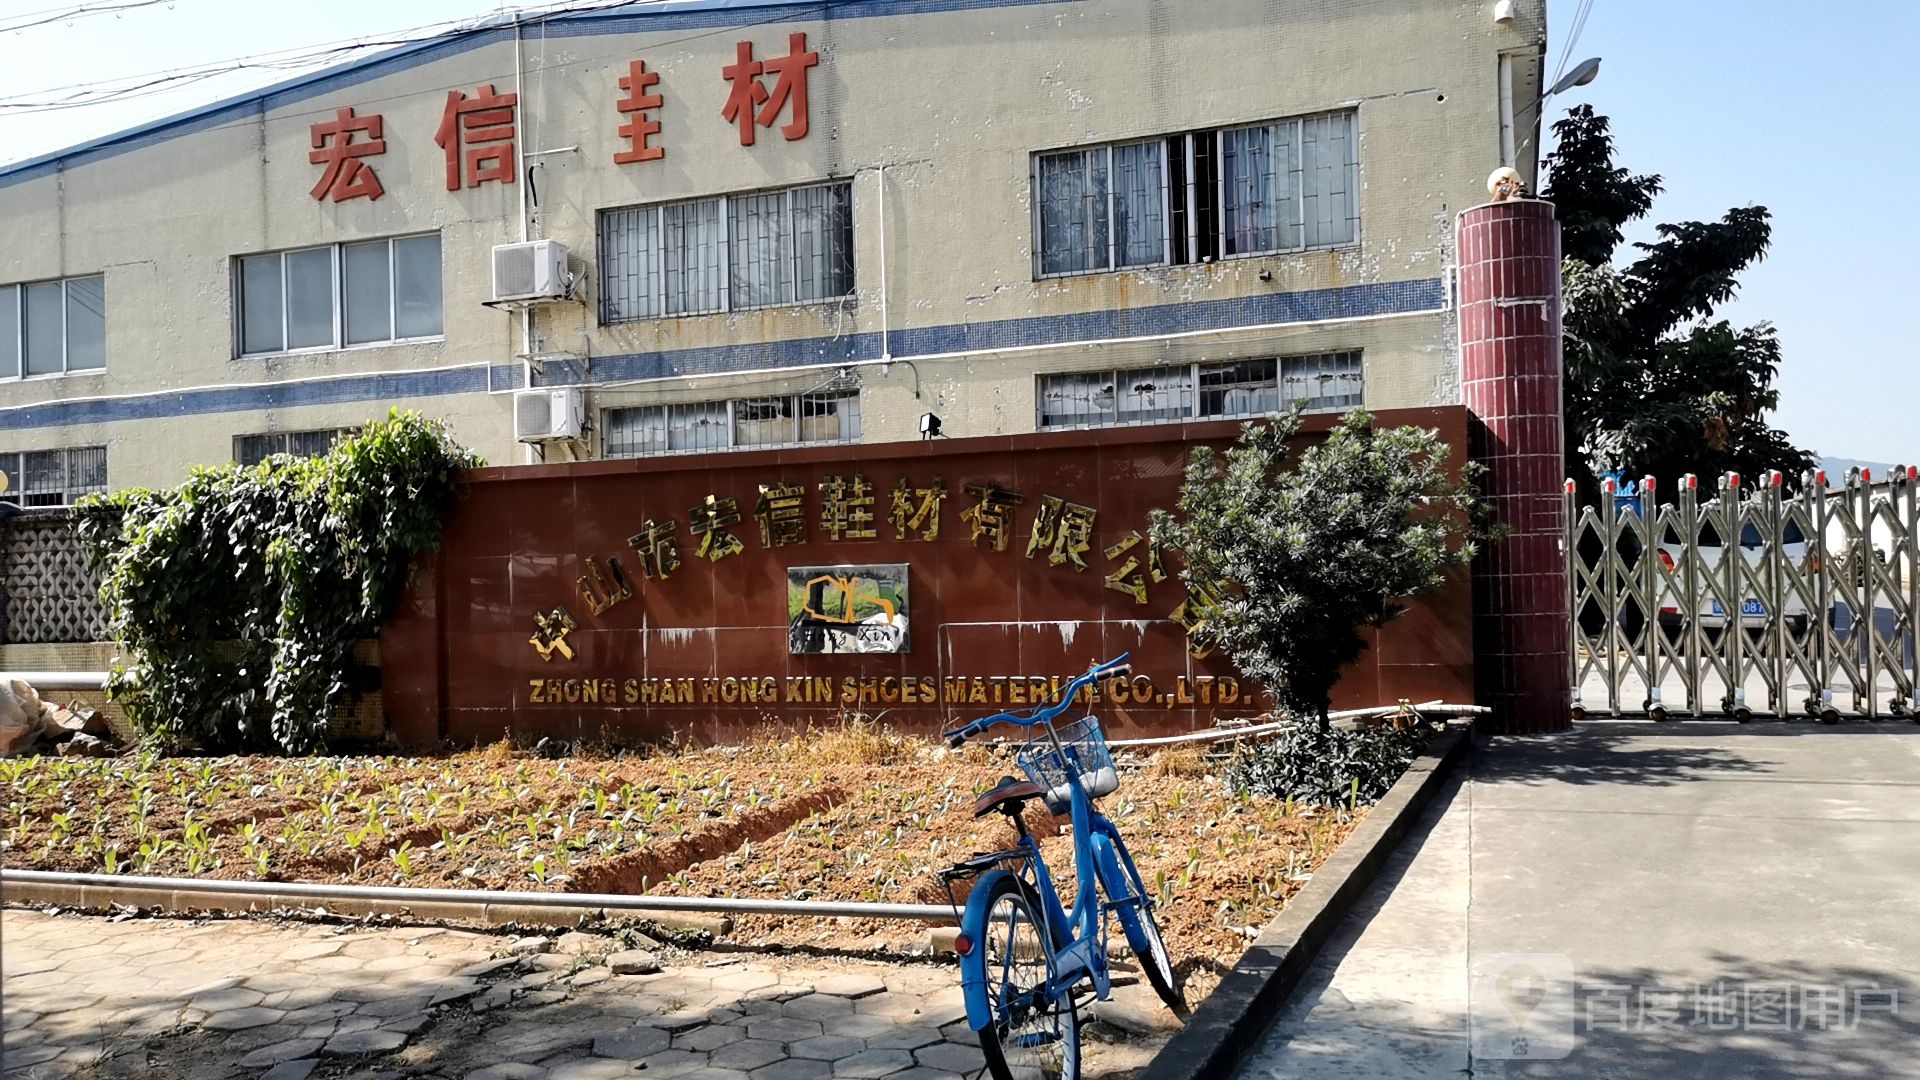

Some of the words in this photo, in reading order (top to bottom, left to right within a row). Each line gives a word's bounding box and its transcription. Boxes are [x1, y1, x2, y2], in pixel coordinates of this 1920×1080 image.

[529, 679, 617, 703] ZHONG
[624, 678, 695, 703] SHAN
[702, 677, 778, 703] HONG
[786, 677, 833, 703] XIN
